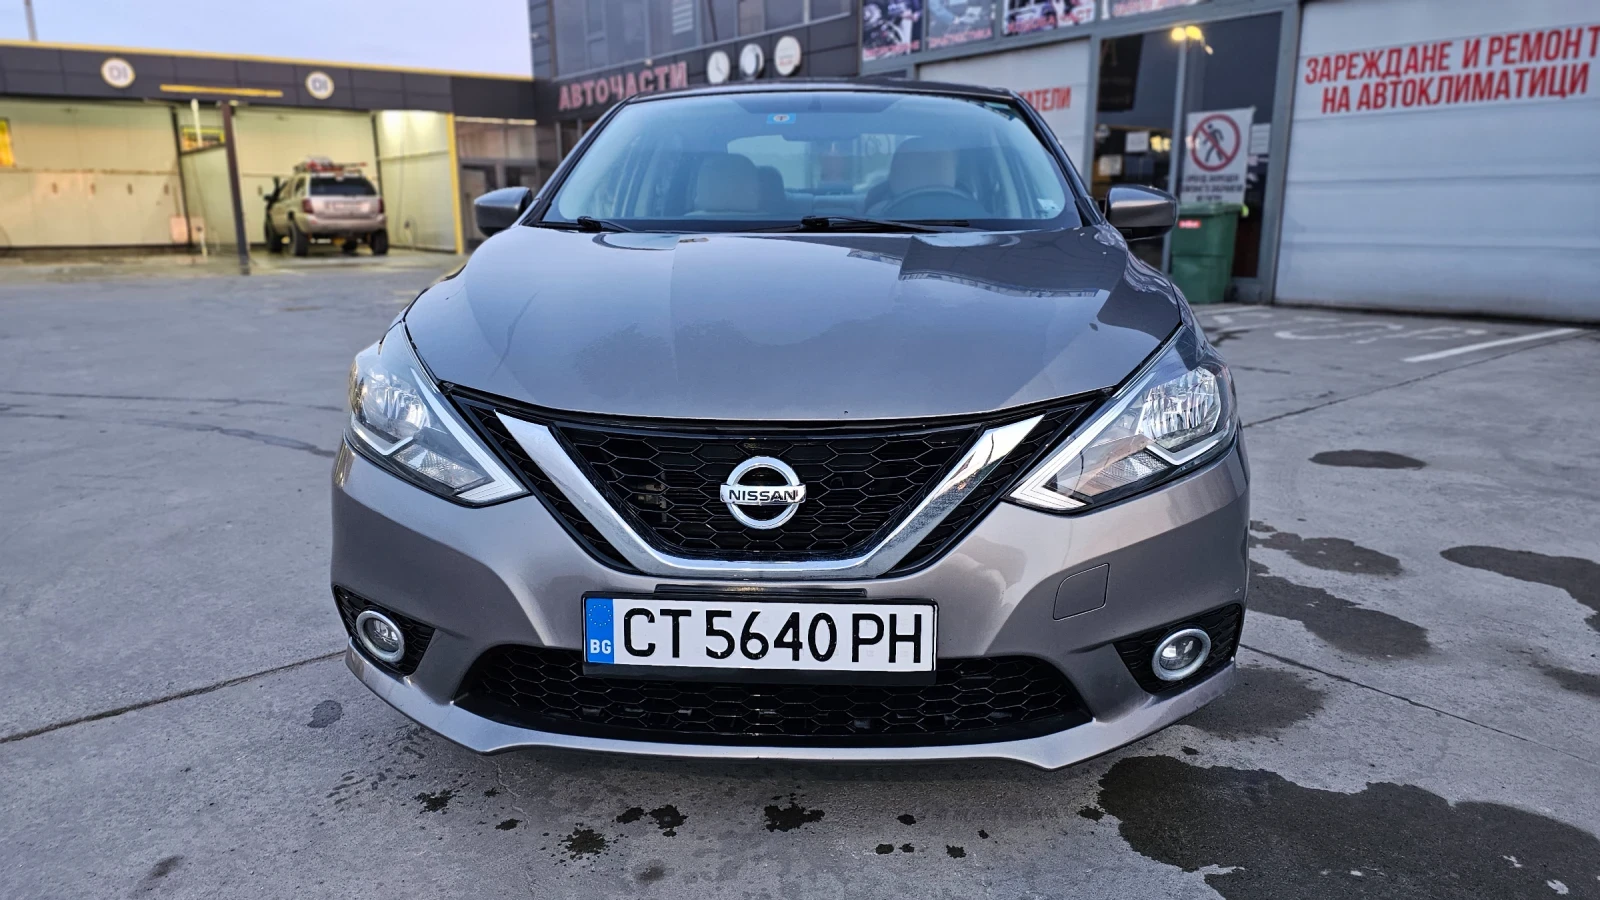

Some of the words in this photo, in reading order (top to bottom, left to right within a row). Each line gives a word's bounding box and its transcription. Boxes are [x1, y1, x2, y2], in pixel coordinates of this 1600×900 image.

[1305, 41, 1452, 85] ЗАРЕЖДАНЕ
[1461, 38, 1481, 69] И
[1485, 25, 1600, 67] РЕМОНТ
[558, 60, 689, 111] АВТОЧАСТИ
[1321, 84, 1350, 114] НА
[1356, 62, 1590, 110] АВТОКЛИМАТИЦИ
[728, 489, 800, 504] NISSAN
[590, 639, 612, 655] BG
[623, 607, 692, 659] CT
[705, 609, 838, 662] 5640
[851, 613, 922, 664] PH
